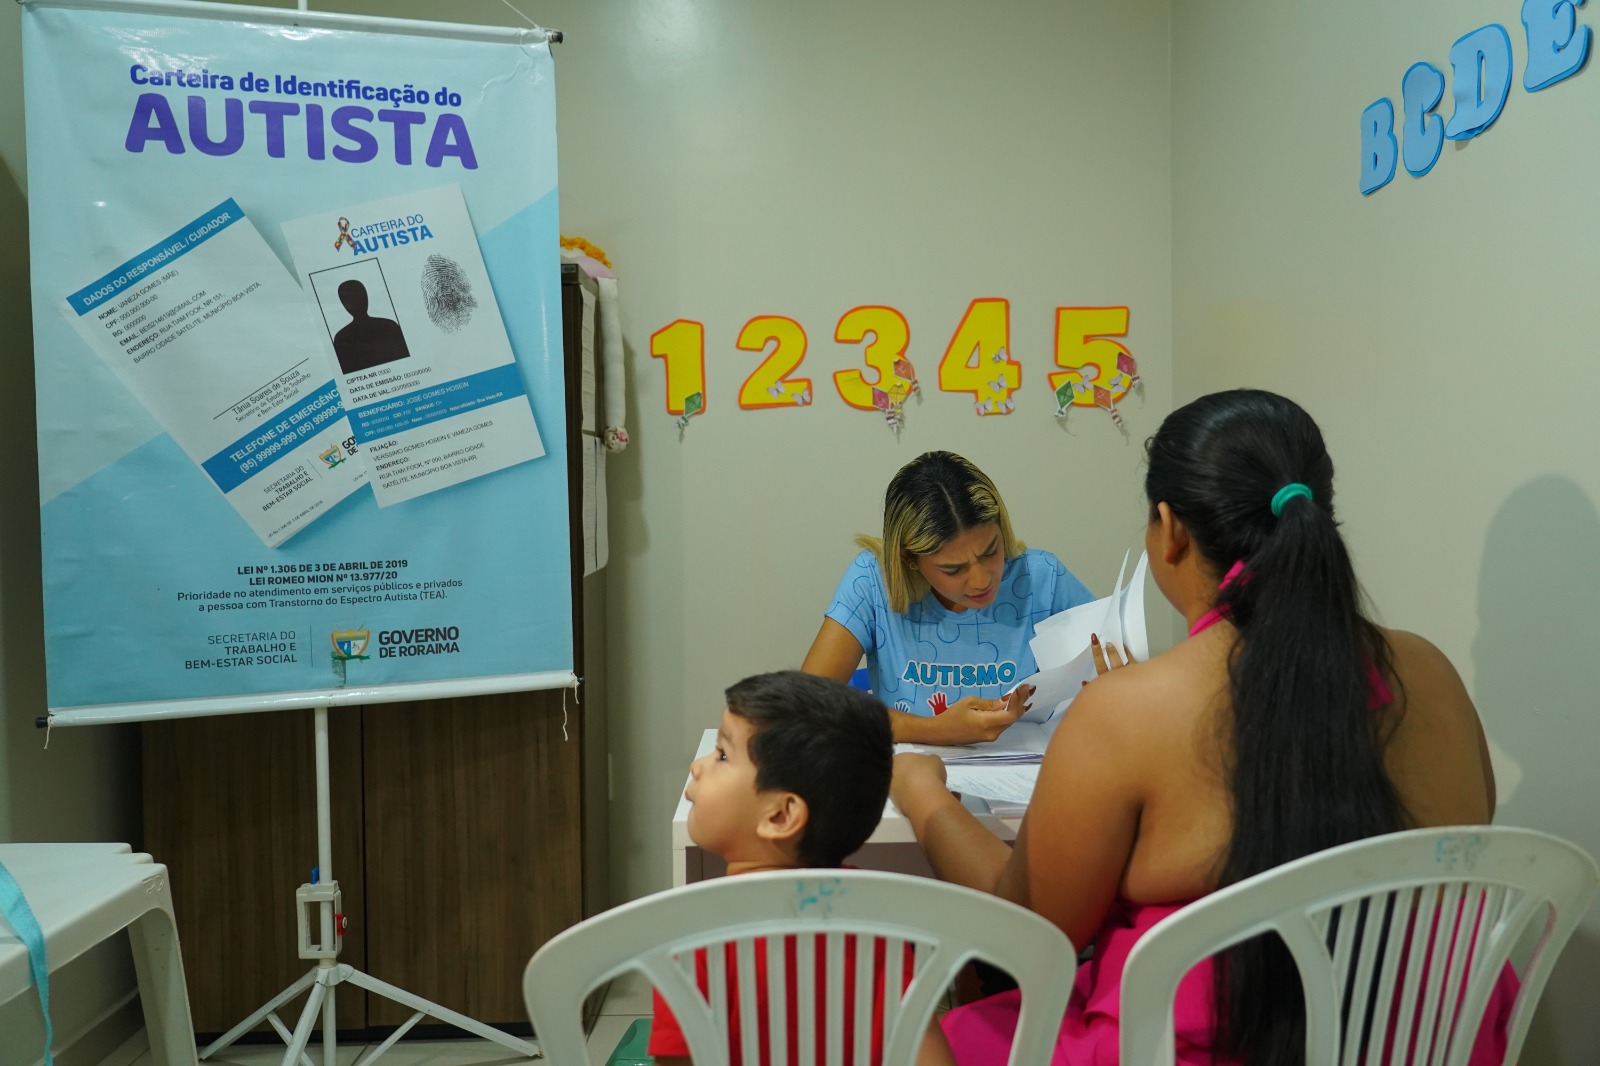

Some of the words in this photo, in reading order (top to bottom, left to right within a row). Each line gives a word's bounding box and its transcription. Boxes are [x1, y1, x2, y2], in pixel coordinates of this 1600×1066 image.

[130, 64, 234, 90] Carteira
[240, 72, 270, 92] de
[275, 74, 430, 108] Identificação
[434, 86, 462, 107] do
[124, 92, 478, 170] AUTISTA
[350, 218, 406, 238] CARTEIRA
[406, 214, 424, 226] DO
[352, 224, 434, 256] AUTISTA
[83, 284, 114, 305] DADOS
[112, 276, 127, 288] DO
[126, 242, 185, 279] RESPONSÁVEL
[188, 212, 230, 241] CUIDADOR
[98, 307, 117, 320] NOME:
[118, 292, 141, 308] VANEZA
[139, 279, 161, 294] GOMES
[161, 270, 178, 282] (MÃE)
[105, 318, 120, 328] CPF:
[112, 329, 123, 337] RG:
[126, 332, 159, 354] ENDEREÇO:
[159, 322, 172, 334] RUA
[170, 315, 186, 326] TIAM
[202, 298, 213, 306] NR
[133, 347, 155, 363] BAIRRO
[155, 333, 176, 349] CIDADE
[202, 299, 232, 319] MUNICÍPIO
[231, 292, 245, 302] BOA
[119, 333, 140, 346] EMAIL:
[650, 319, 706, 415] 1
[736, 314, 812, 410] 2
[833, 304, 915, 411] 3
[938, 298, 1022, 415] 4
[1047, 306, 1136, 408] 5
[232, 401, 251, 414] Tânia
[249, 388, 272, 404] Soares
[271, 382, 280, 390] de
[279, 370, 300, 384] Souza
[349, 385, 365, 394] DATA
[374, 375, 403, 386] EMISSÃO:
[352, 394, 368, 403] DATA
[358, 400, 404, 418] BENEFICIÁRIO:
[422, 388, 445, 399] GOMES
[230, 429, 277, 461] TELEFONE
[275, 420, 290, 433] DE
[239, 458, 257, 473] (95)
[256, 431, 297, 461] 99999-999
[296, 421, 314, 436] (95)
[347, 446, 358, 455] DE
[369, 440, 398, 452] FILIAÇÃO:
[403, 441, 424, 452] GOMES
[376, 456, 409, 470] ENDEREÇO:
[263, 471, 295, 493] SECRETARIA
[294, 465, 304, 473] DO
[274, 473, 304, 494] TRABALHO
[262, 488, 293, 511] BEM-ESTAR
[292, 476, 313, 491] SOCIAL
[237, 566, 254, 575] LEI
[256, 566, 268, 574] Nº
[270, 564, 297, 574] 1.306
[299, 564, 312, 572] DE
[315, 564, 320, 572] 3
[323, 563, 336, 571] DE
[338, 562, 368, 571] ABRIL
[370, 561, 383, 569] DE
[386, 560, 408, 568] 2019
[250, 577, 266, 586] LEI
[267, 576, 305, 585] ROMEO
[307, 574, 334, 583] MION
[336, 574, 348, 582] Nº
[350, 571, 398, 581] 13.977/20
[177, 590, 231, 601] Prioridade
[249, 588, 312, 598] atendimento
[314, 587, 329, 595] em
[331, 583, 372, 594] serviços
[374, 582, 413, 592] públicos
[424, 579, 463, 590] privados
[208, 602, 244, 613] pessoa
[246, 601, 267, 609] com
[269, 598, 323, 608] Transtorno
[325, 597, 338, 605] do
[340, 594, 382, 605] Espectro
[384, 593, 418, 602] Autista
[420, 591, 448, 600] (TEA).
[208, 632, 278, 645] SECRETARIA
[280, 630, 296, 640] DO
[378, 626, 459, 646] GOVERNO
[225, 643, 286, 655] TRABALHO
[290, 642, 296, 651] E
[379, 647, 397, 658] DE
[398, 642, 460, 657] RORAIMA
[185, 657, 254, 670] BEM-ESTAR
[256, 654, 298, 665] SOCIAL
[902, 660, 1016, 688] AUTISMO
